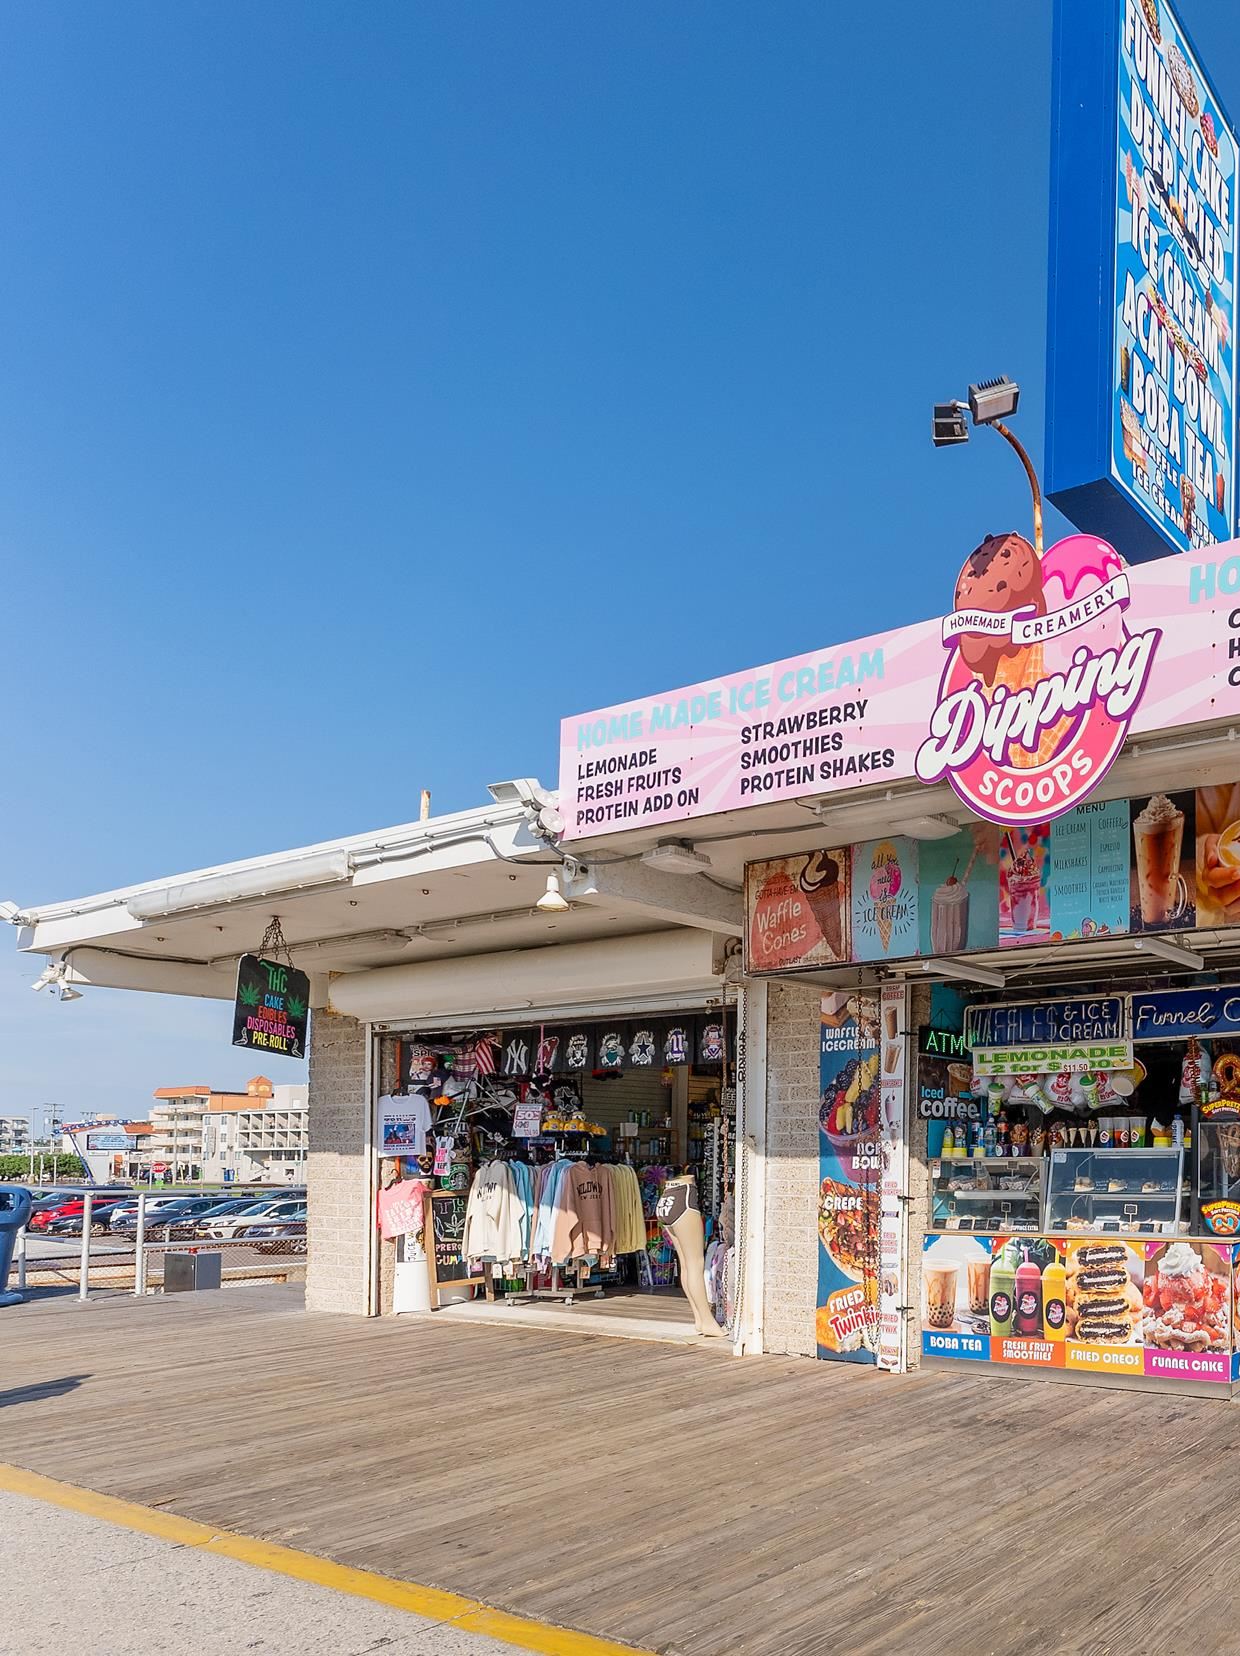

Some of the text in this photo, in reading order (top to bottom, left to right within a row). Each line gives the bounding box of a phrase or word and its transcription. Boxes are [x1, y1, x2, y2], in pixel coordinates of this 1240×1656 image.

[1125, 3, 1230, 236] FUNNEL CAKE
[1130, 76, 1227, 285] DEEP FRIED
[1143, 166, 1211, 290] OREOS
[1131, 184, 1221, 377] ICE CREAM
[1122, 272, 1225, 458] ACAI BOWL
[1132, 350, 1215, 506] BOBA TEA
[1139, 424, 1178, 488] WAFFLE
[1155, 466, 1165, 489] &
[1132, 459, 1186, 534] ICE CREAM
[950, 615, 1006, 630] HOMEMADE
[1022, 584, 1116, 639] CREAMERY
[577, 648, 885, 752] HOME MADE ICE CREAM
[915, 628, 1160, 781] Dipping
[741, 699, 868, 745] STRAWBERRY
[740, 732, 843, 770] SMOOTHIES
[578, 748, 657, 781] LEMONADE
[740, 748, 895, 796] PROTEIN SHAKES
[577, 767, 682, 803] FRESH FRUITS
[979, 749, 1093, 807] SCOOPS
[576, 787, 700, 826] PROTEIN ADD ON
[1076, 802, 1106, 815] MENU
[757, 898, 802, 933] Waffle
[862, 904, 909, 923] ICE CREAM
[762, 924, 807, 955] Cones
[260, 962, 288, 993] THC
[265, 994, 284, 1010] CAKE
[1063, 1005, 1077, 1021] &
[1081, 1002, 1110, 1019] ICE
[258, 1006, 287, 1024] EDIBLES
[1137, 1005, 1215, 1031] Funnel
[247, 1016, 295, 1038] DISPOSABLES
[826, 1026, 871, 1039] WAFFLE &
[1059, 1023, 1117, 1041] CREAM
[253, 1031, 287, 1050] PRE-ROLL
[822, 1038, 876, 1052] ICECREAM
[926, 1031, 964, 1055] ATM
[978, 1045, 1127, 1064] LEMONADE
[991, 1065, 1004, 1073] 2
[1010, 1063, 1041, 1072] for
[1063, 1063, 1088, 1072] $11.50
[921, 1086, 944, 1098] Iced
[921, 1099, 978, 1117] coffee
[824, 1197, 863, 1210] CREPE
[830, 1290, 865, 1313] FRIED
[930, 1336, 982, 1351] BOBA TEA
[1003, 1341, 1054, 1352] FRESH FRUIT
[1003, 1350, 1052, 1361] SMOOTHIES
[1070, 1350, 1140, 1366] FRIED OREOS
[1152, 1356, 1224, 1373] FUNNEL CAKE
